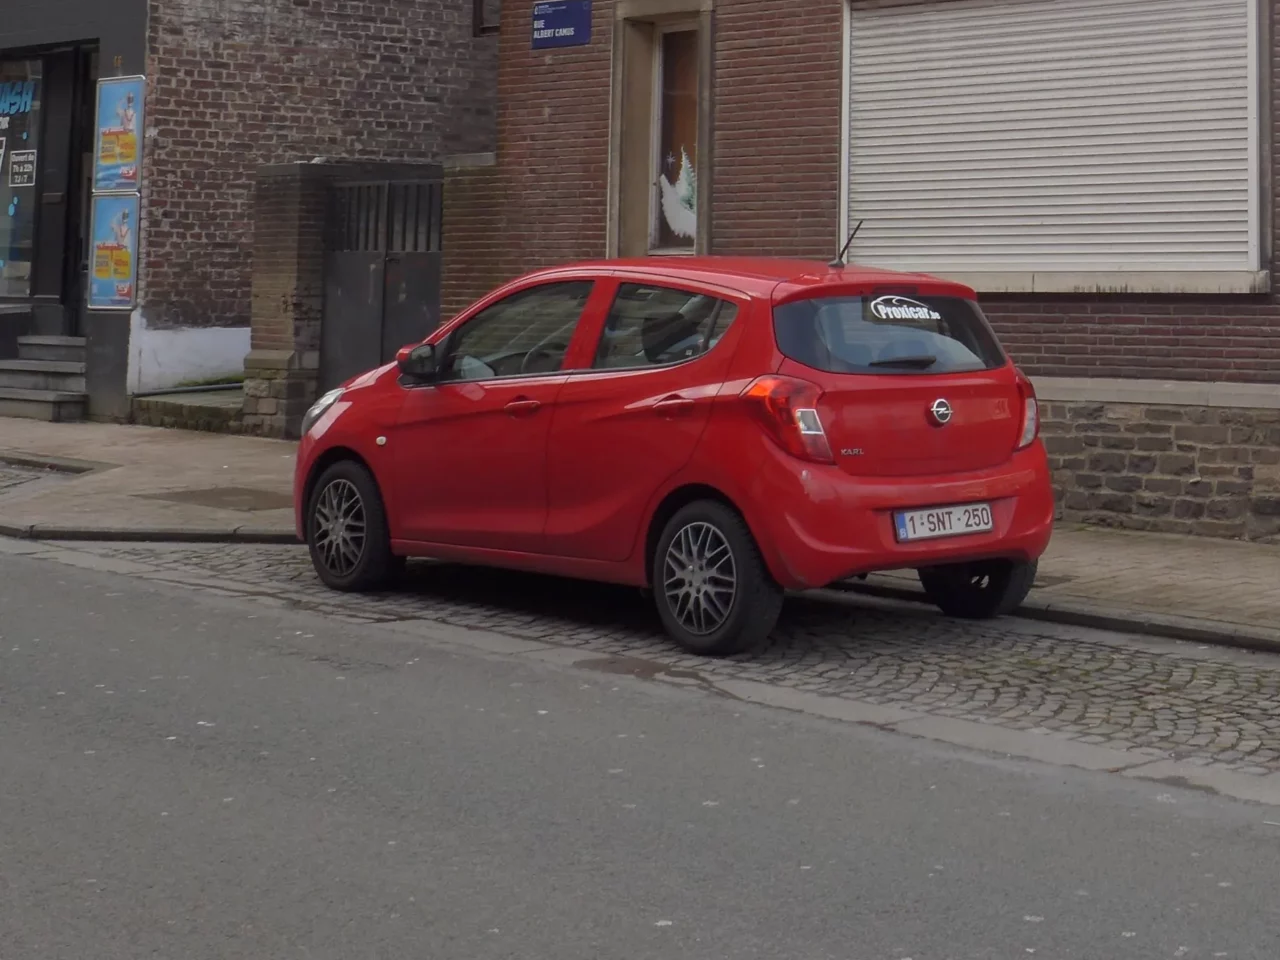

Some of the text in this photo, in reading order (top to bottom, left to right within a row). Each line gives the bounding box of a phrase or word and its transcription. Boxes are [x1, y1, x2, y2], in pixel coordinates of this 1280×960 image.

[533, 20, 545, 29] RUE
[533, 27, 575, 39] ALBERT CAMUS
[840, 448, 865, 456] KARL
